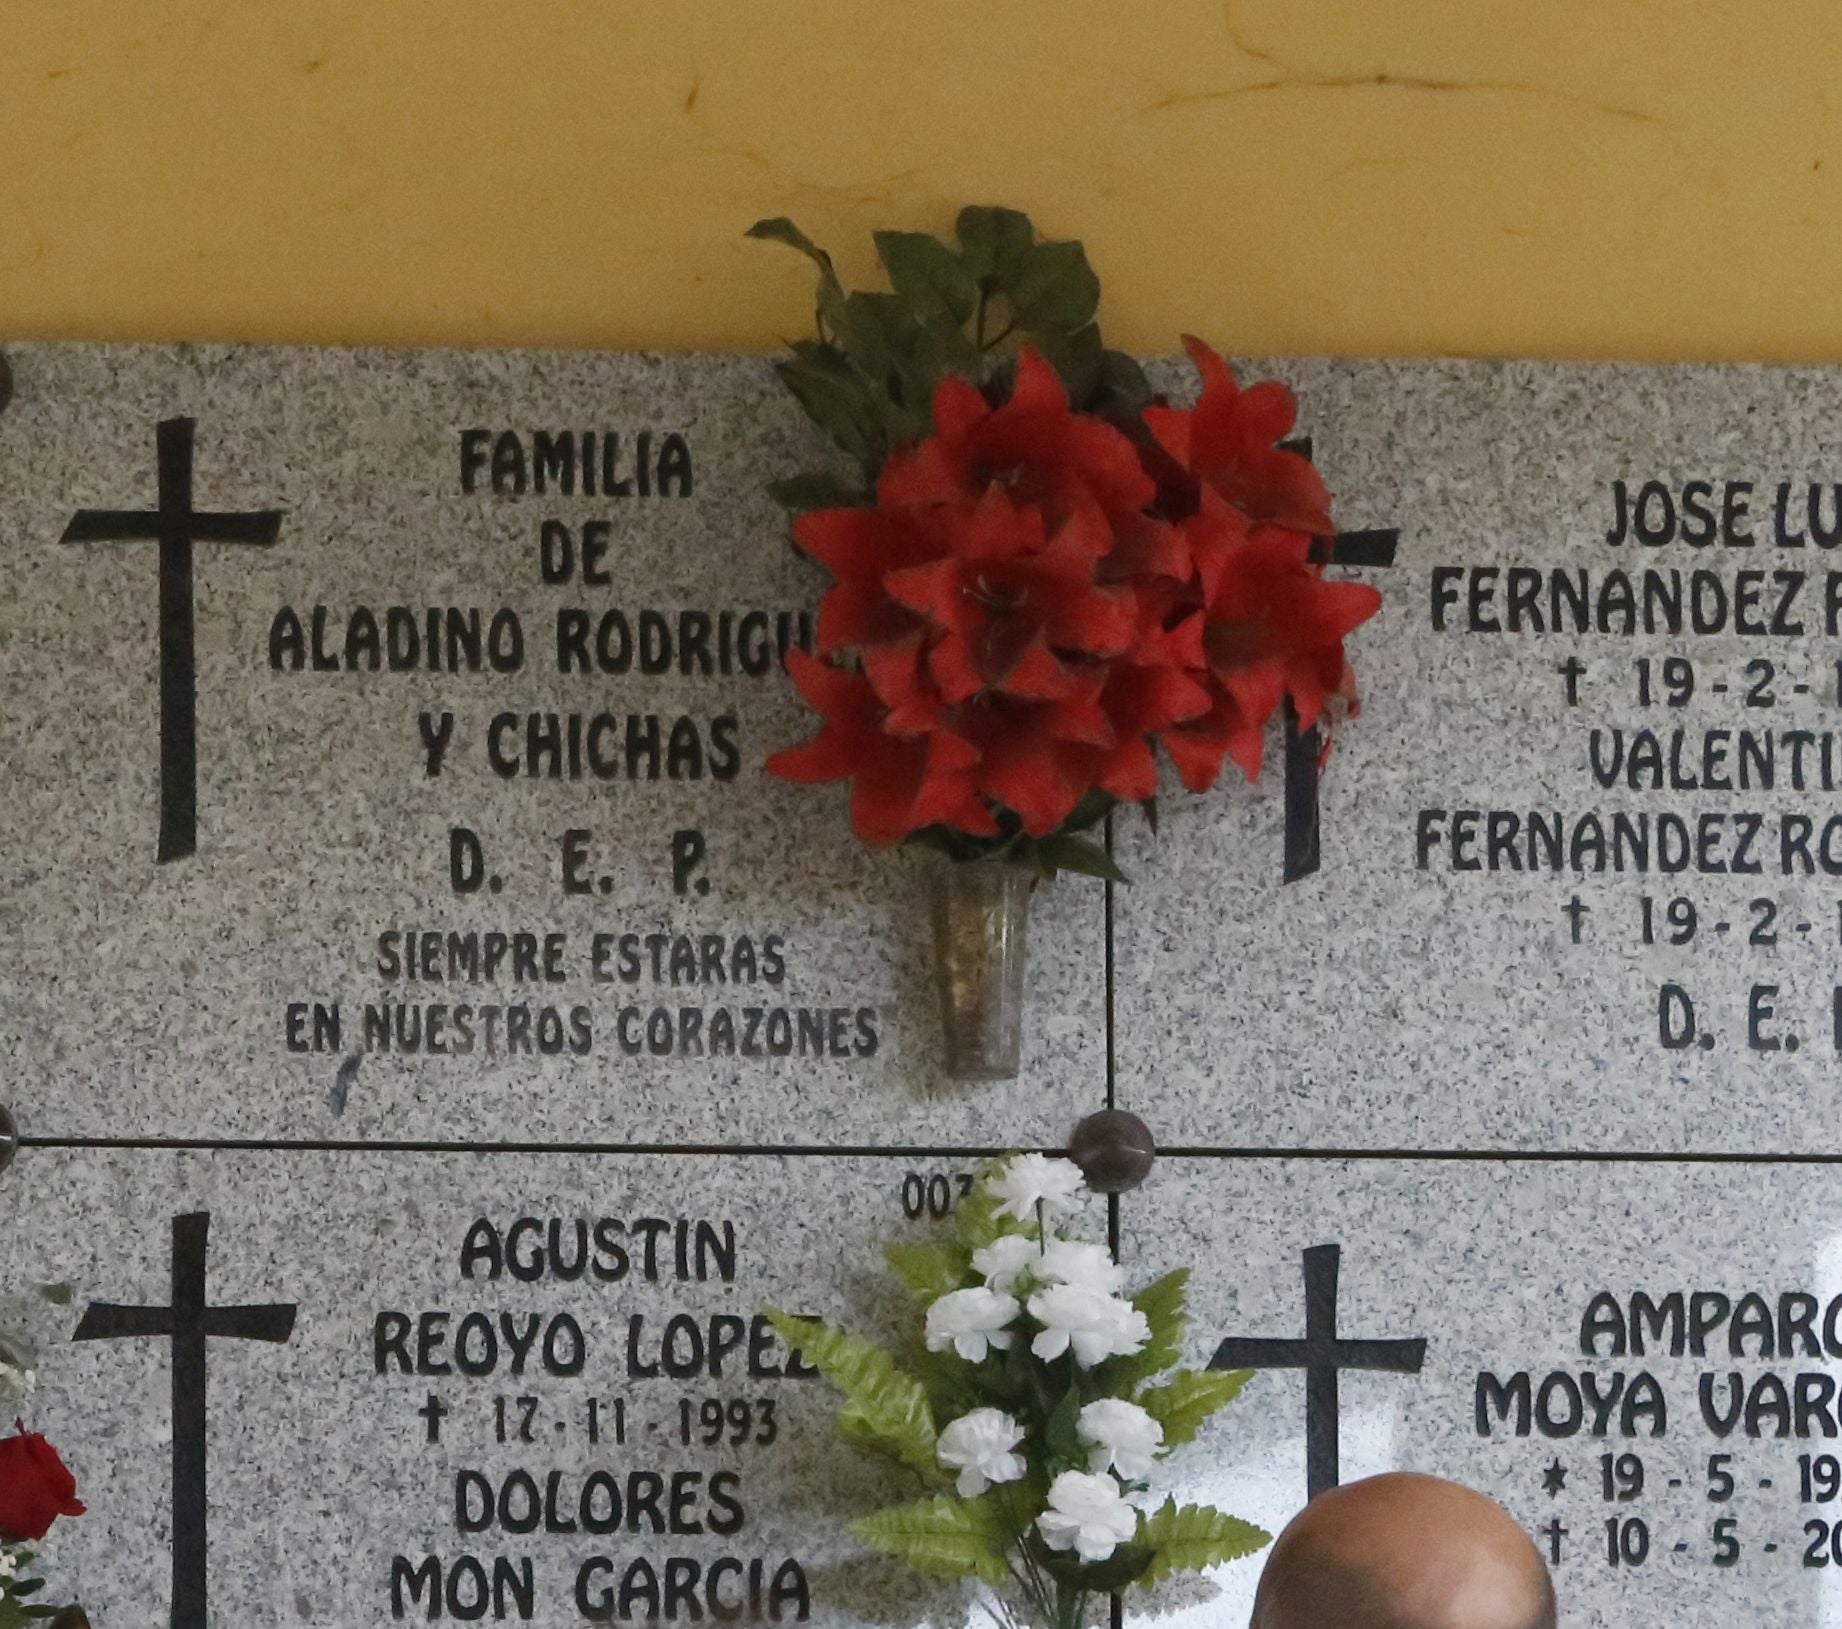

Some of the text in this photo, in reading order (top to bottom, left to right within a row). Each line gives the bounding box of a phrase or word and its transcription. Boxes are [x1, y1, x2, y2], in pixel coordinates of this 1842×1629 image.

[460, 430, 693, 499] FAMILIA
[1606, 480, 1842, 549] JOSE LU
[541, 520, 612, 586] DE
[1431, 566, 1804, 636] FERNANDEZ
[269, 606, 524, 673] ALADINO
[418, 712, 741, 782] Y CHICHAS
[1590, 729, 1834, 791] VALENTI
[449, 828, 709, 895] D. E. P.
[1416, 810, 1762, 875] FERNANDEZ
[377, 931, 786, 985] SIEMPRE ESTARAS
[286, 1002, 879, 1057] EN NUESTROS CORAZONES
[1657, 984, 1715, 1050] D.
[1748, 984, 1799, 1052] E.
[460, 1217, 736, 1283] AGUSTIN
[373, 1311, 585, 1378] REOYO
[1475, 1371, 1842, 1438] MOYA VAR
[455, 1469, 745, 1535] DOLORES
[390, 1555, 811, 1622] MON GARCIA
